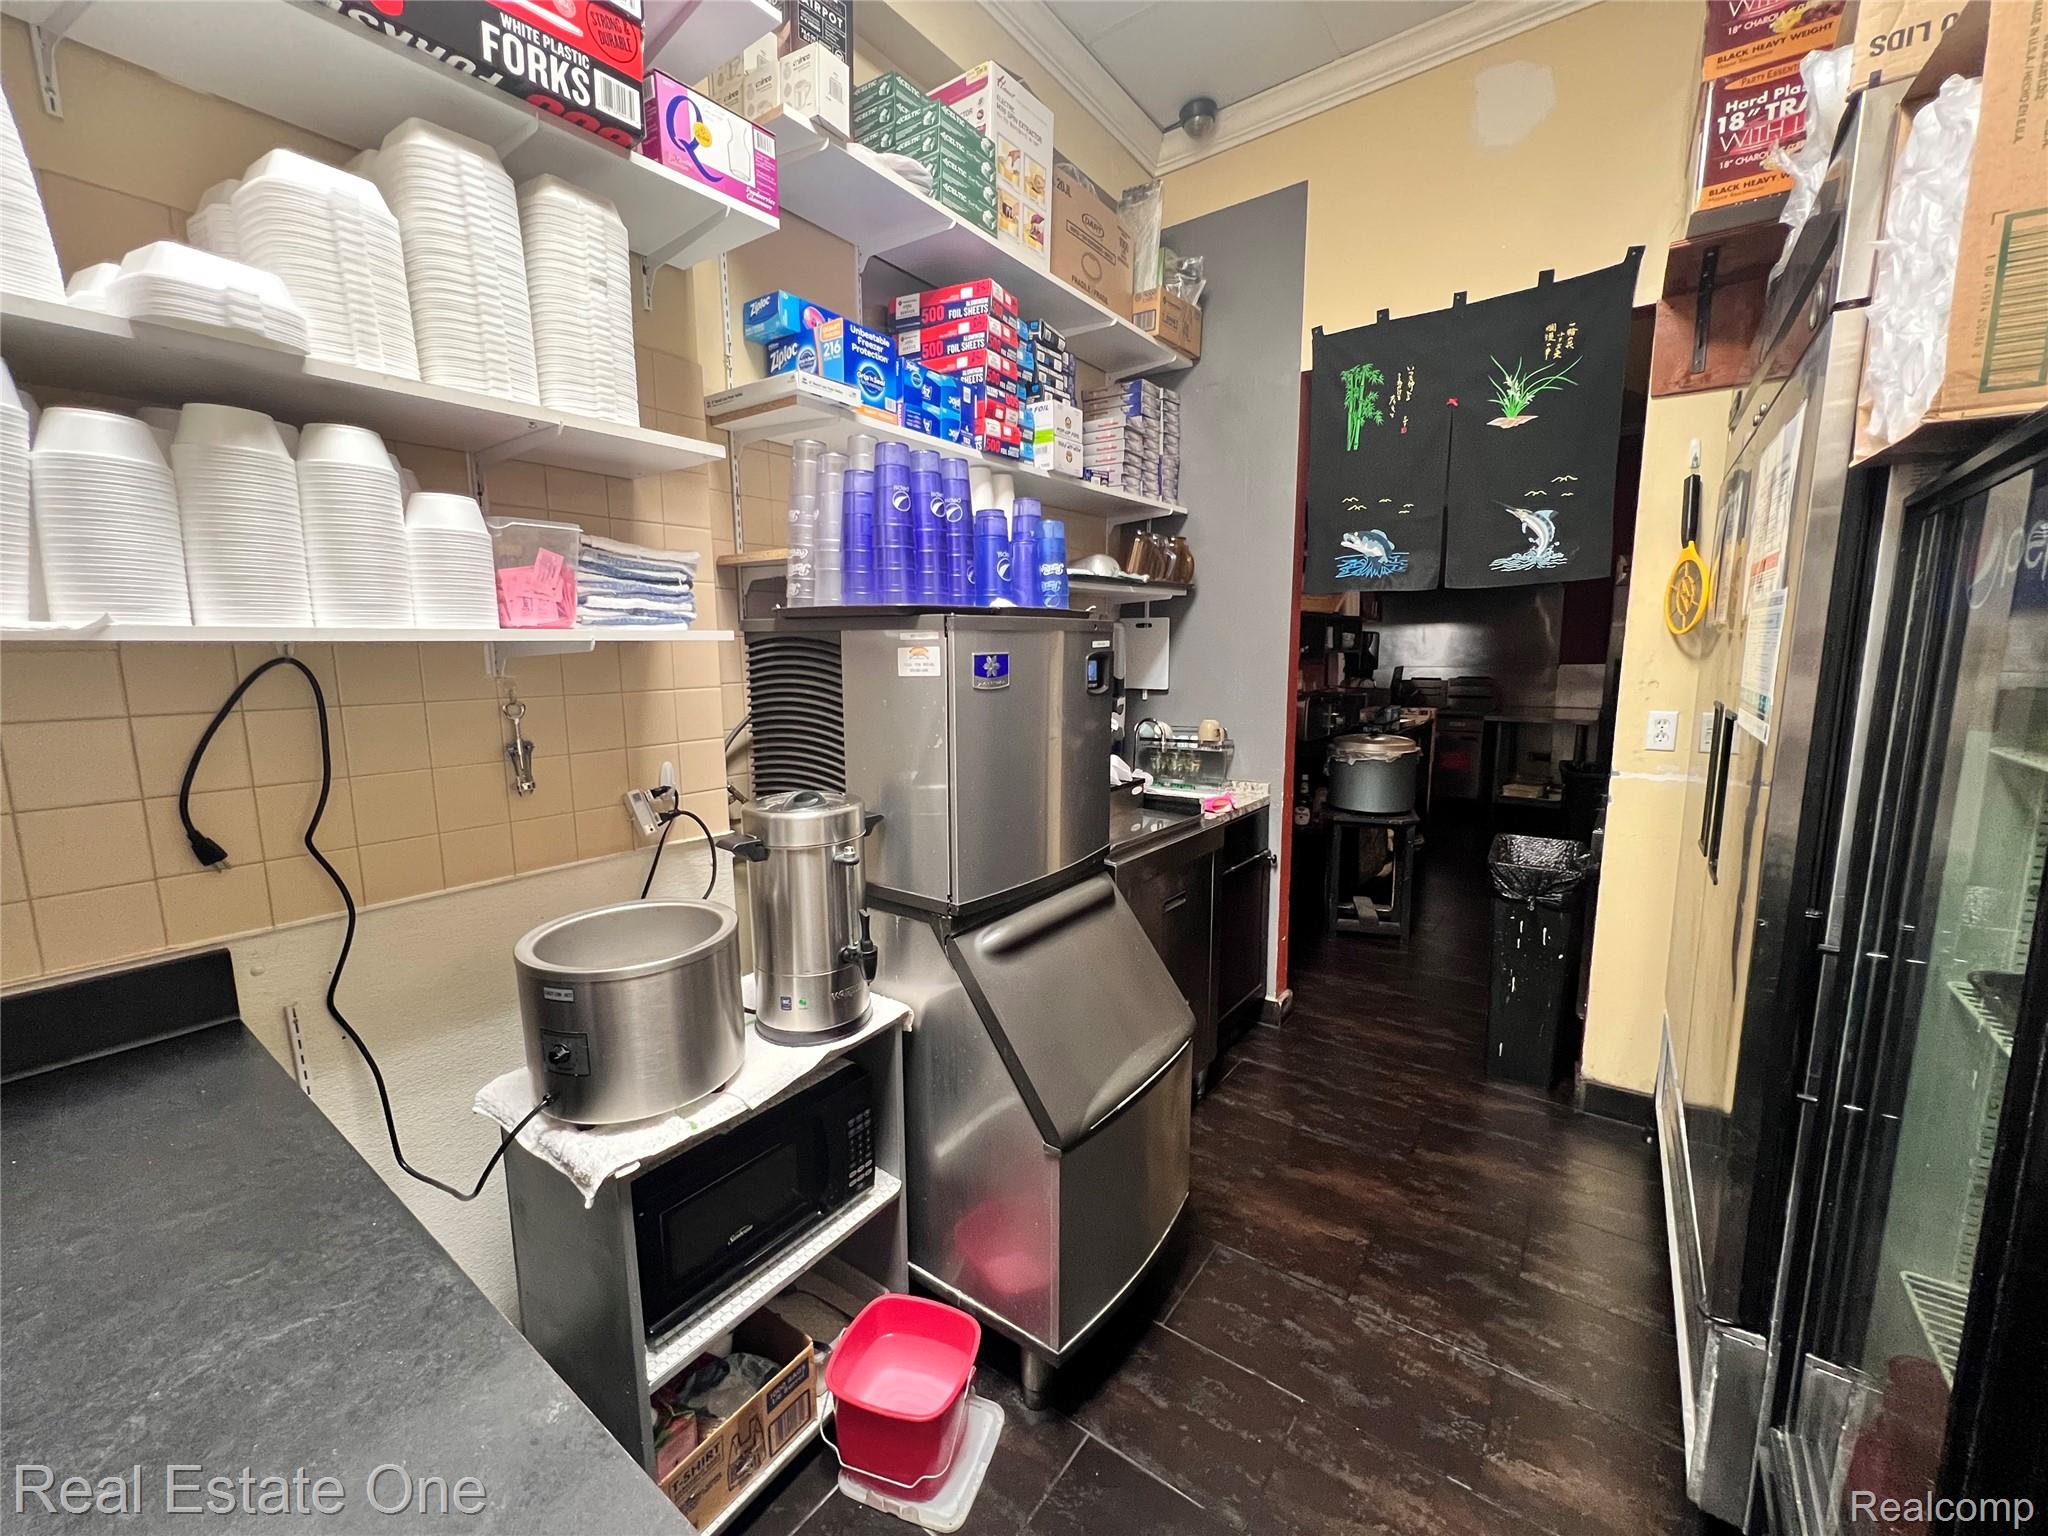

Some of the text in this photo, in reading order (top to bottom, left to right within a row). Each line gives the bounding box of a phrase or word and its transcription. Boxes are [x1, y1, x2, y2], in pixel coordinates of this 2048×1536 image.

[590, 11, 621, 36] STRONG
[500, 12, 590, 70] WHITE PLASTIC
[597, 29, 632, 53] DURABLE
[1717, 48, 1749, 64] BLACK
[1752, 37, 1787, 53] HEAVY
[1790, 21, 1834, 41] WEIGHT
[1869, 20, 1931, 57] LIDS
[481, 20, 591, 107] FORKS
[1741, 73, 1766, 87] PARTY
[1725, 90, 1768, 113] Hard
[1720, 120, 1784, 152] WITH
[1709, 184, 1739, 197] BLACK
[1743, 175, 1777, 189] HEAVY
[1084, 216, 1102, 233] DART
[750, 296, 771, 317] Ziploc
[921, 304, 945, 323] 500
[948, 308, 962, 319] FOIL
[964, 304, 989, 316] SHEETS
[850, 324, 890, 348] Unbeatable
[857, 335, 884, 353] Freezer
[770, 342, 799, 373] Ziploc
[823, 340, 841, 358] 216
[851, 342, 889, 364] Protection
[921, 339, 985, 359] 500 FOIL SHEETS
[671, 1442, 721, 1492] T-SHIRT
